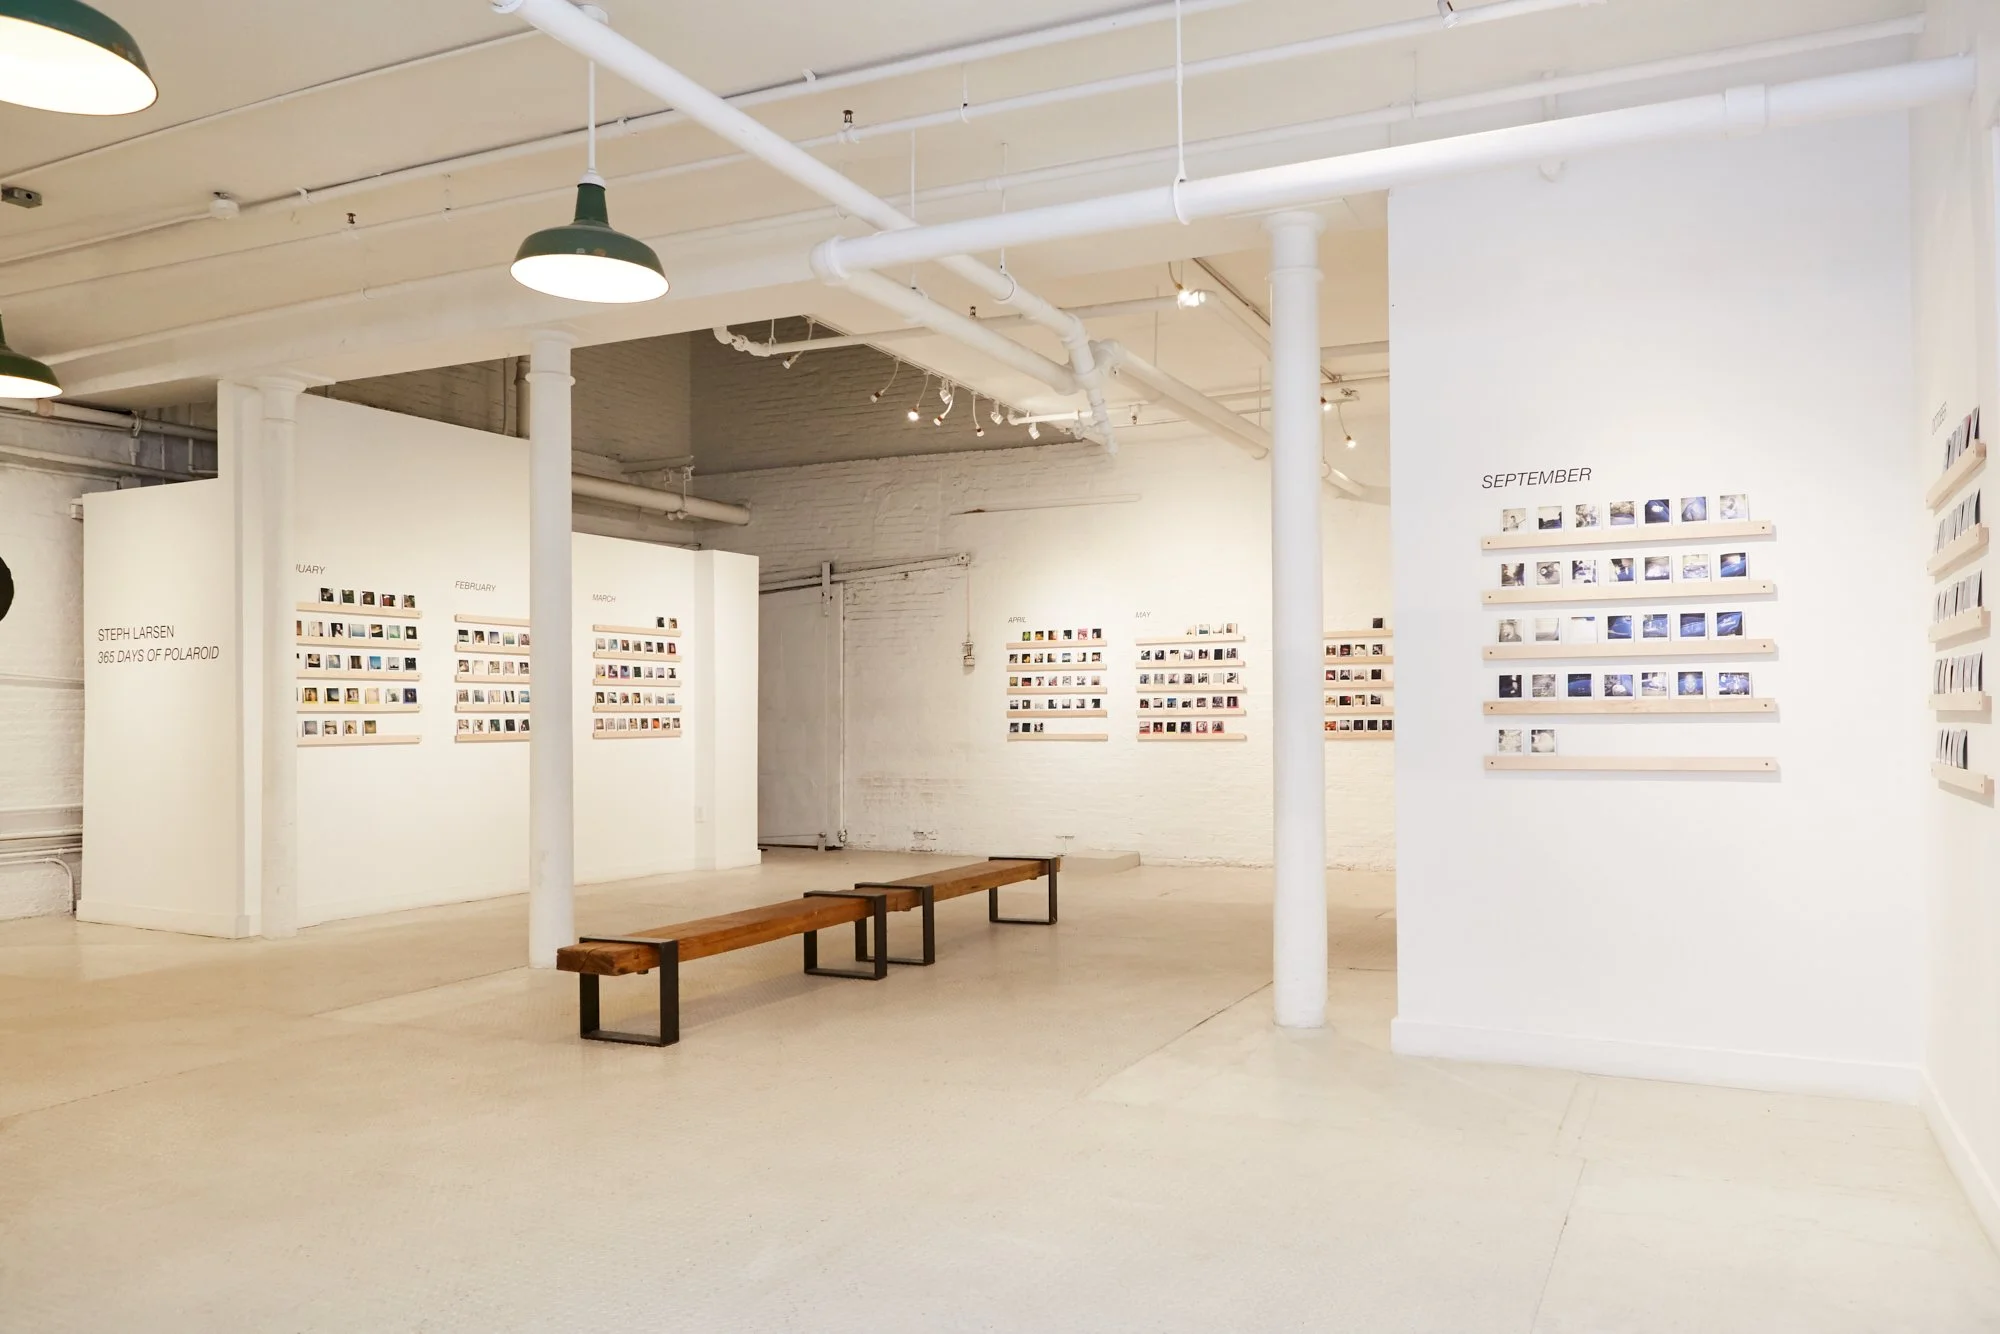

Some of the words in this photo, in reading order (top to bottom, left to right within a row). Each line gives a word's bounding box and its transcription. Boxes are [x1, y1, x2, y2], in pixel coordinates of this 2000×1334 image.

[1481, 467, 1592, 489] SEPTEMBER
[455, 580, 496, 591] FEBRUARY
[592, 593, 616, 603] MARCH
[1007, 616, 1027, 624] APRIL
[1135, 611, 1151, 619] MAY
[98, 627, 130, 641] STEPH
[133, 625, 175, 640] LARSEN
[97, 650, 115, 664] 365
[117, 648, 144, 663] DAYS
[146, 648, 162, 662] OF
[164, 645, 220, 661] POLAROID
